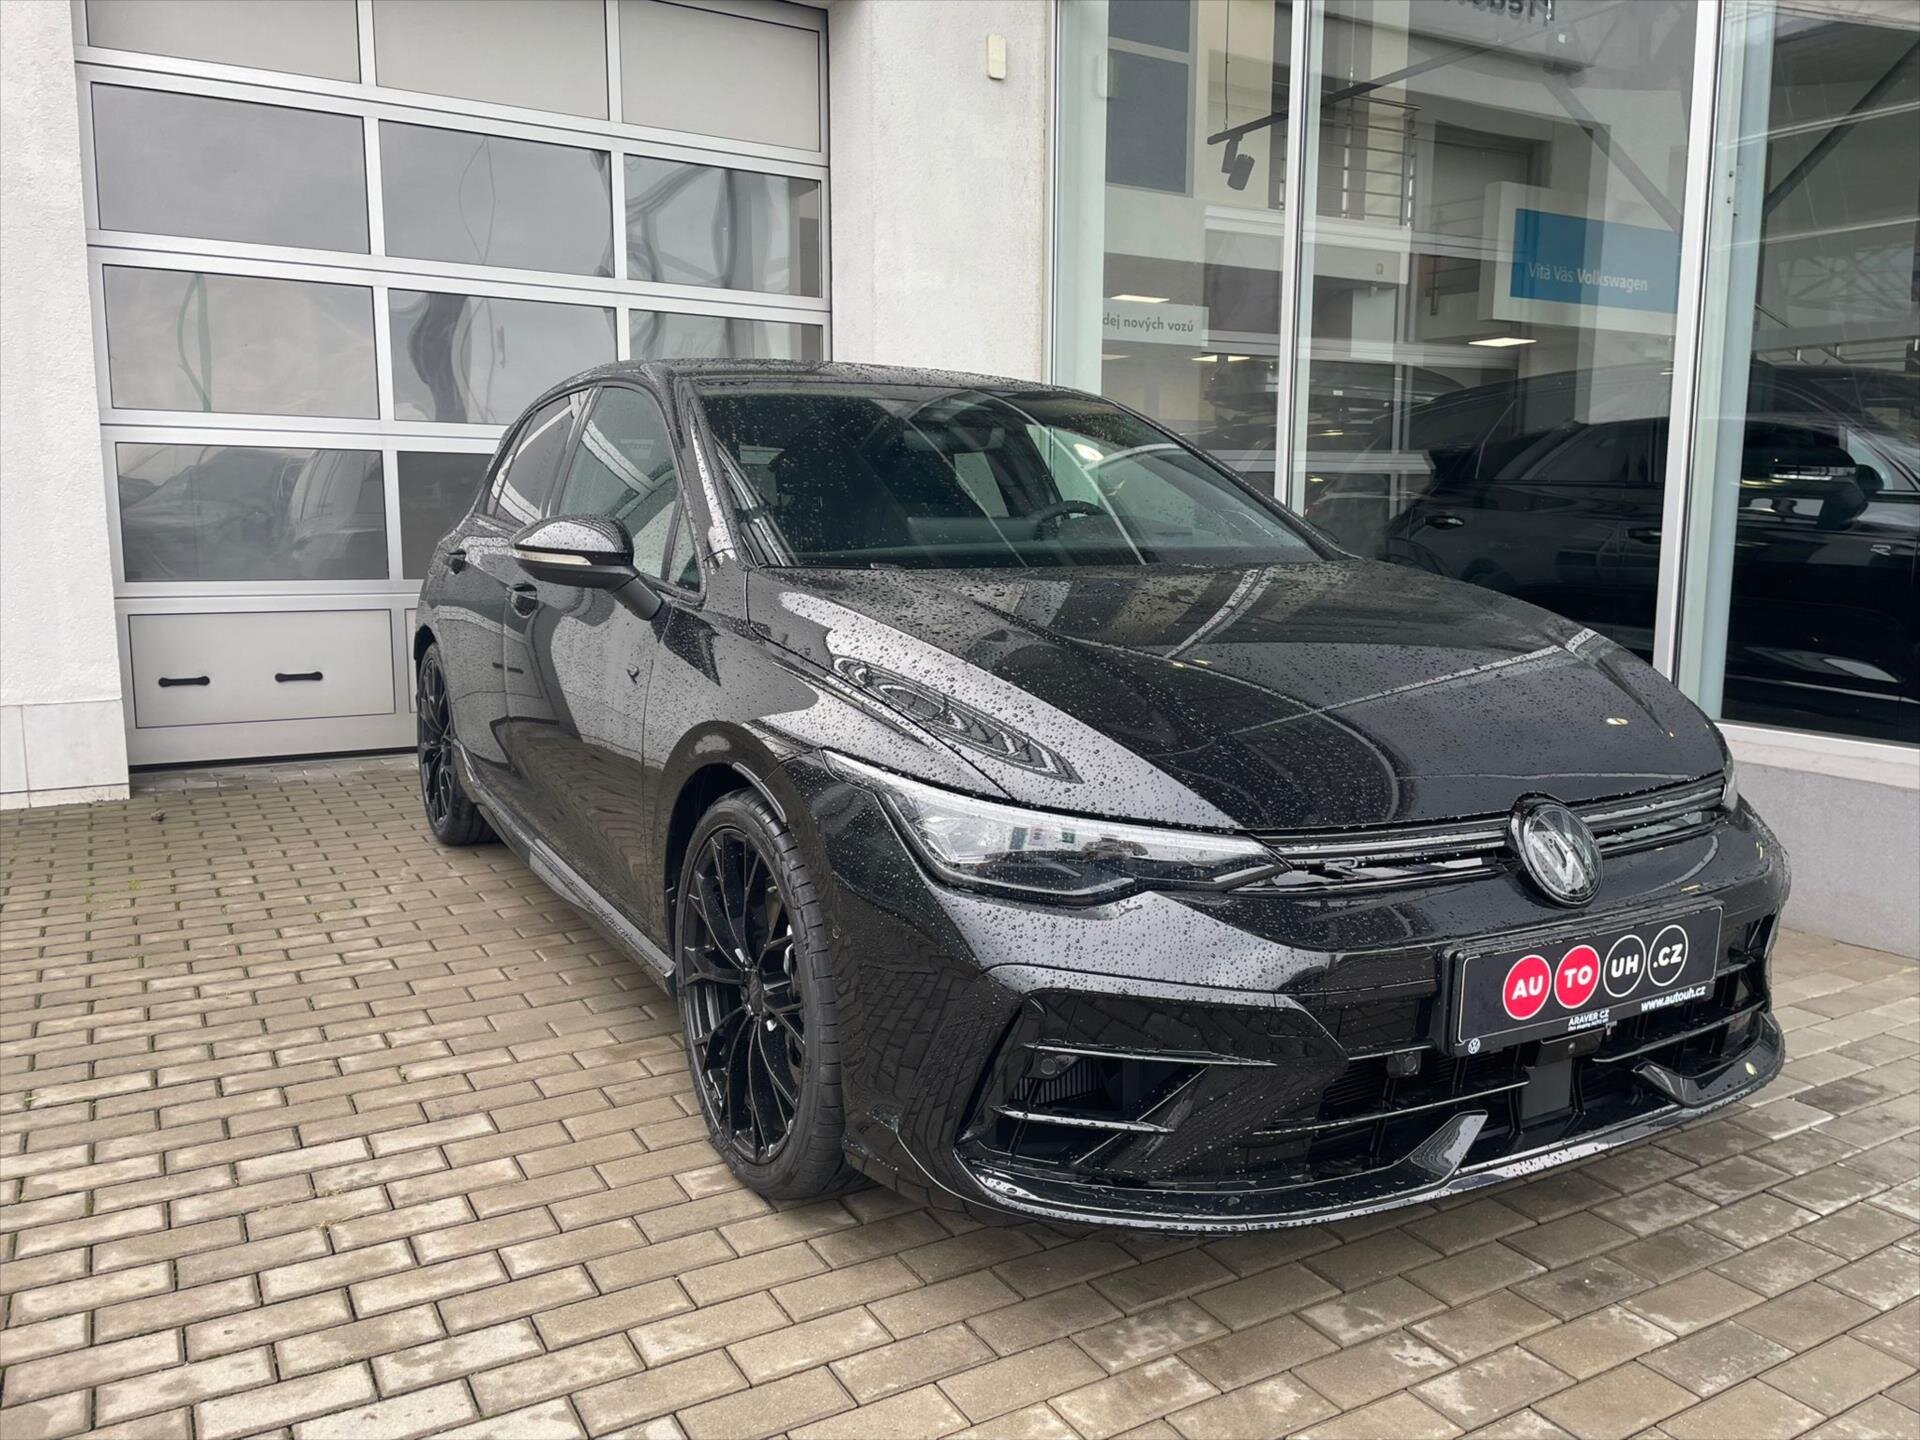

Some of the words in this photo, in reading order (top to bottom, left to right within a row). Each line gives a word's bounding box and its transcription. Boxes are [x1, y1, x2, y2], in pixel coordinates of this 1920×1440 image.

[1577, 268, 1648, 293] Volkswagen
[1123, 316, 1164, 333] nových
[1512, 979, 1543, 1000] AU
[1565, 967, 1593, 988] TO
[1611, 954, 1639, 978] UH
[1641, 986, 1706, 1012] www.autouh.cz
